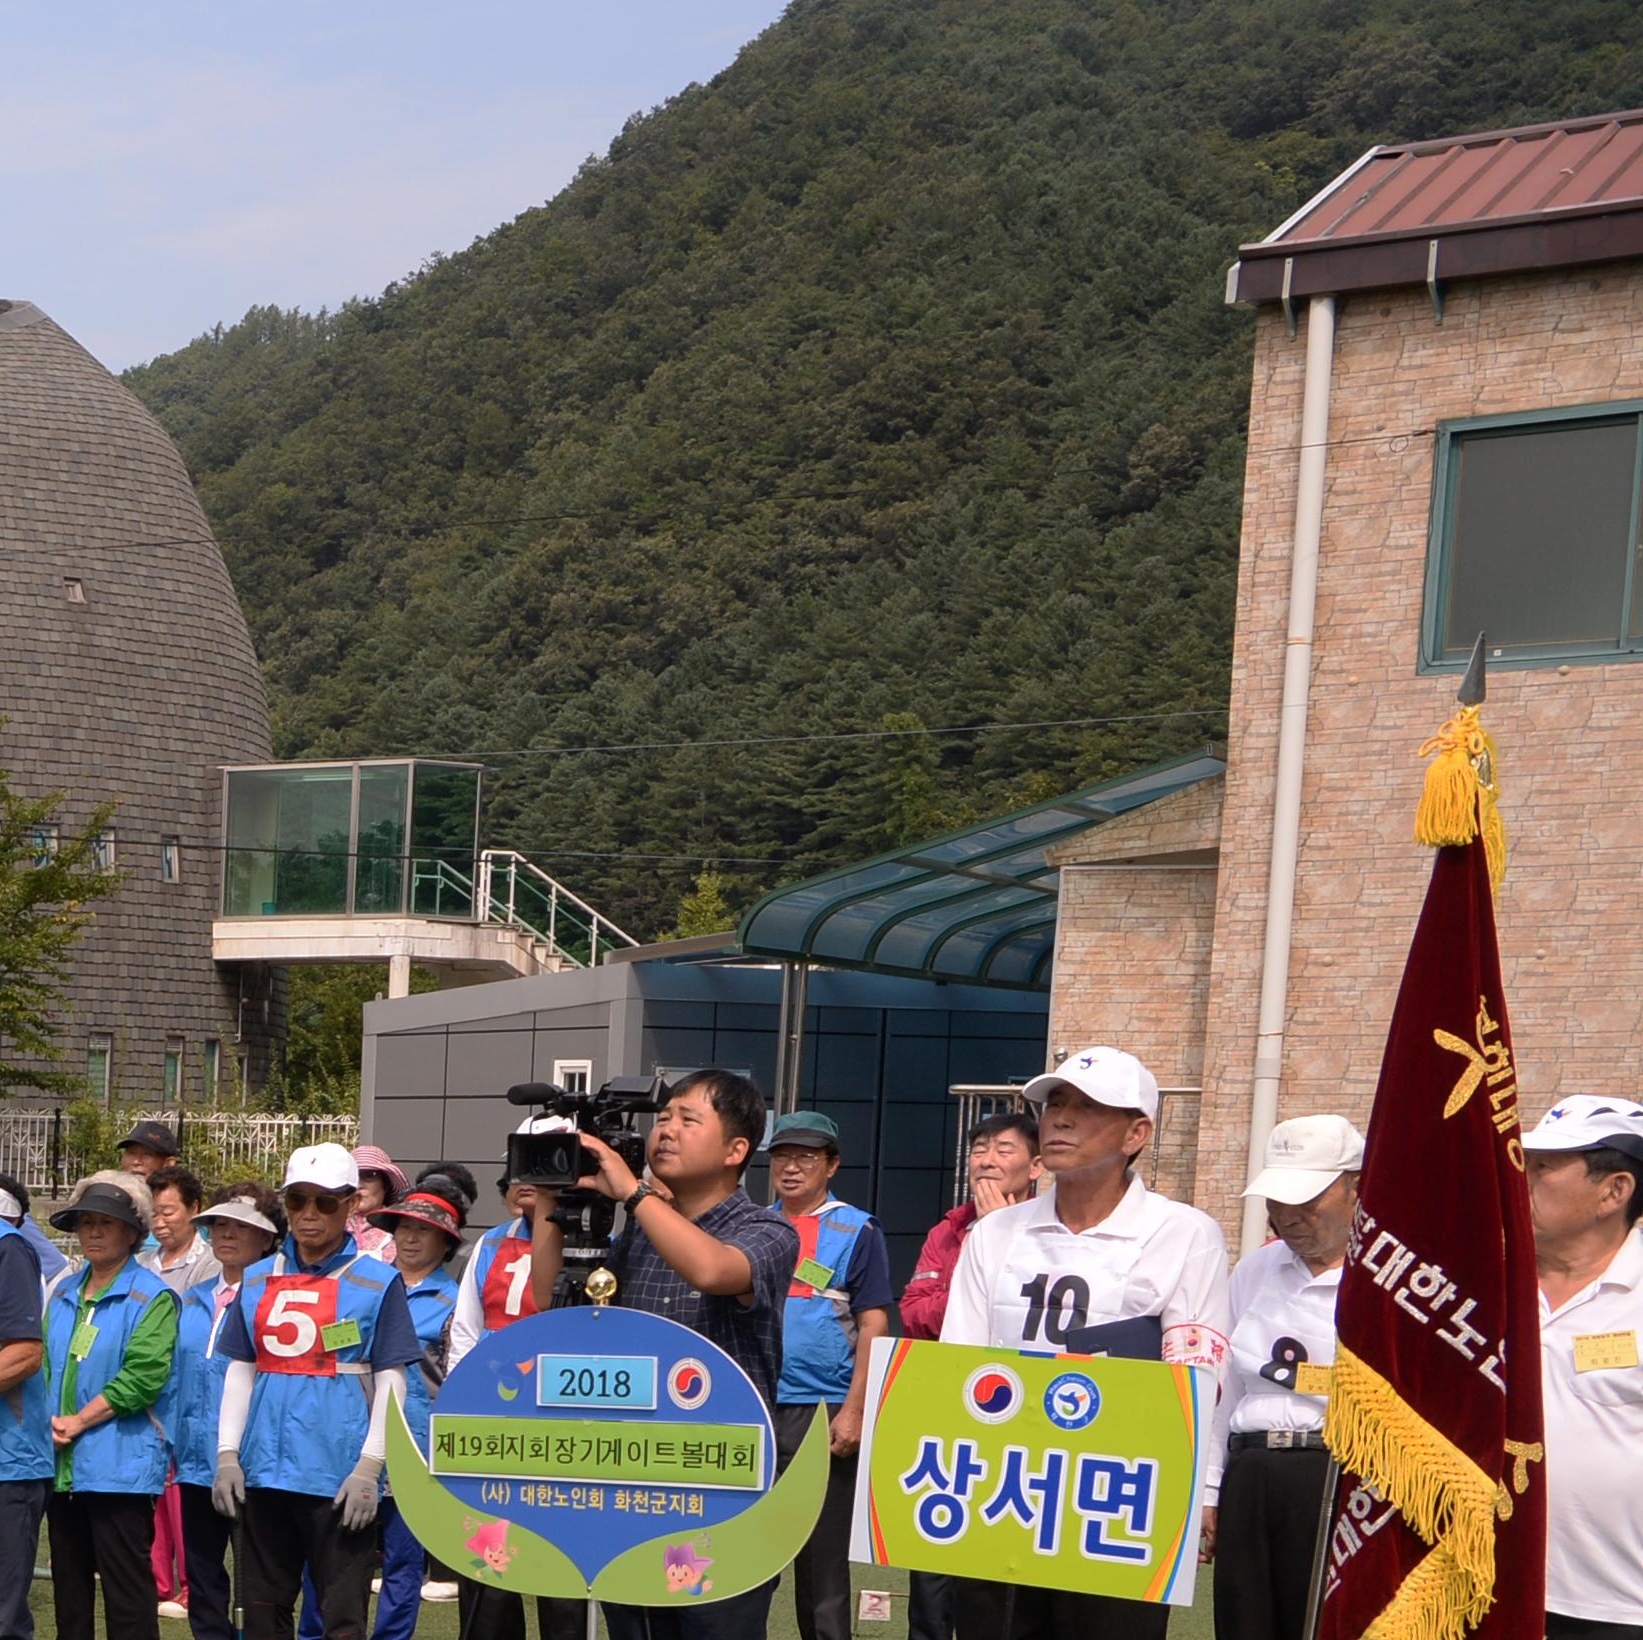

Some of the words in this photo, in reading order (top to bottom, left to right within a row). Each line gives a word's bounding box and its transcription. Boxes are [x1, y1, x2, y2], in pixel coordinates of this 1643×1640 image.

[262, 1290, 320, 1358] 5
[1020, 1273, 1090, 1346] 10
[558, 1368, 632, 1399] 2018
[1259, 1336, 1308, 1390] 8
[481, 1481, 511, 1506] (사)
[520, 1484, 605, 1511] 대한노인회
[614, 1488, 705, 1518] 화천군지회
[901, 1435, 1159, 1565] 상서면
[867, 1594, 882, 1612] 2
